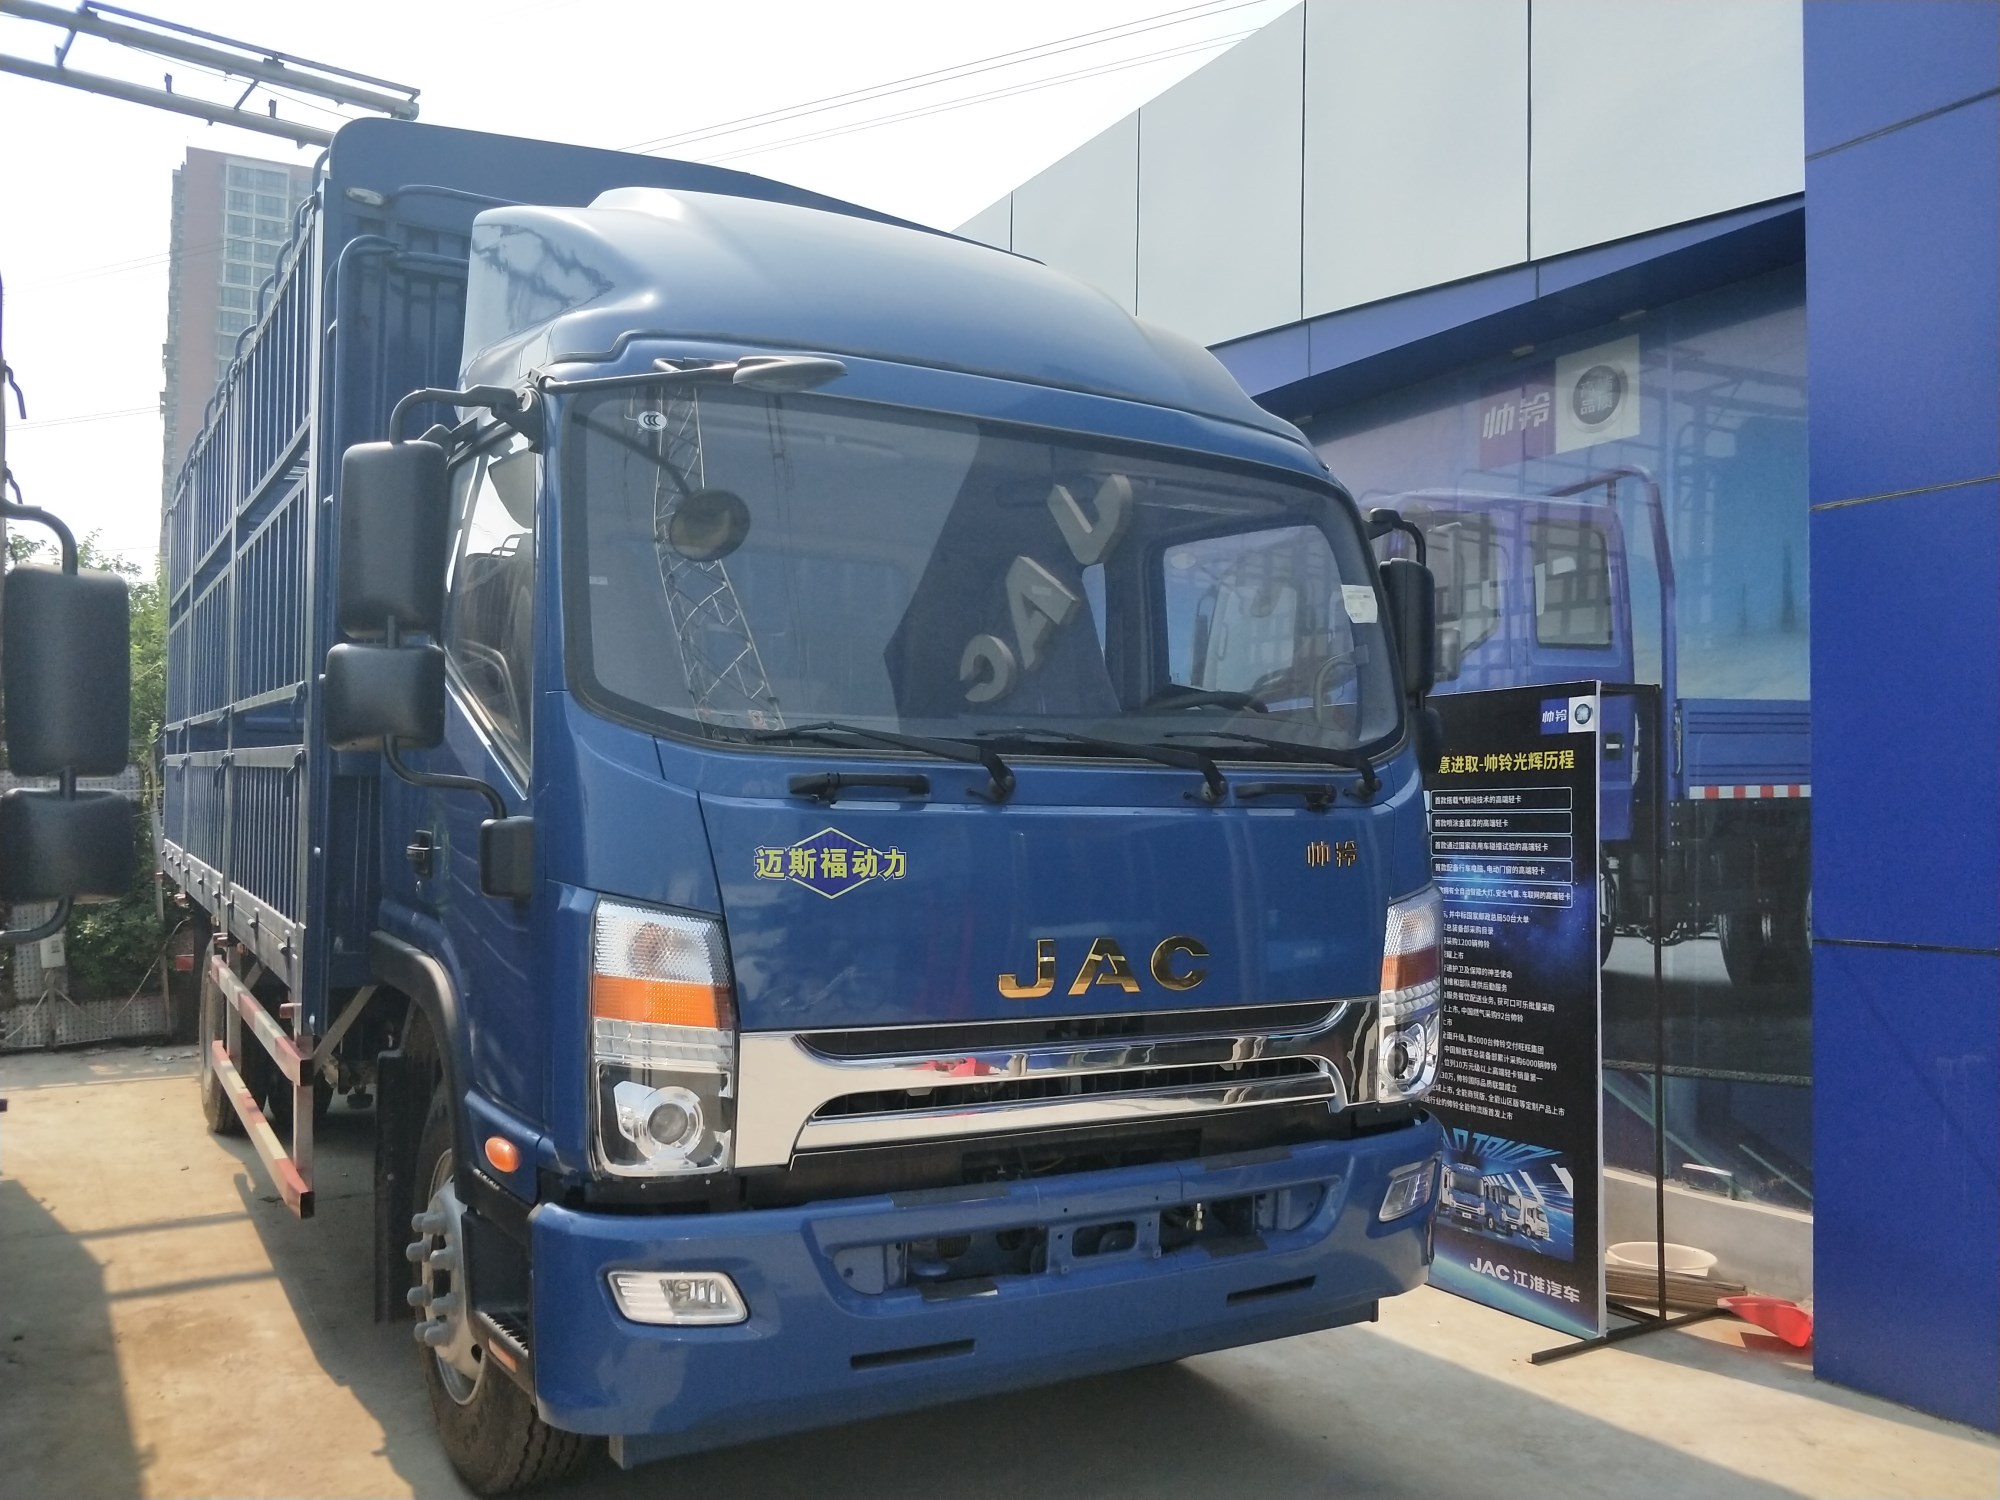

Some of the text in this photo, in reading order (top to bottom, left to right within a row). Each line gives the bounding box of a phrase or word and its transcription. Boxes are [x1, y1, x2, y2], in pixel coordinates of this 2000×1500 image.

[1482, 391, 1551, 440] 帅铃
[1541, 709, 1568, 723] 帅铃
[1438, 749, 1575, 774] 意进取-帅铃光辉历程
[1434, 818, 1509, 828] 首款喷涂金属漆的高端轻卡
[755, 847, 907, 879] 迈斯福动力
[1307, 840, 1358, 868] 帅铃
[997, 935, 1210, 999] JAC
[1440, 1071, 1518, 1094] 30万，帅铃国际品质联盟成立
[1458, 1165, 1476, 1173] JAC
[1469, 1257, 1580, 1303] JAC 江淮汽车
